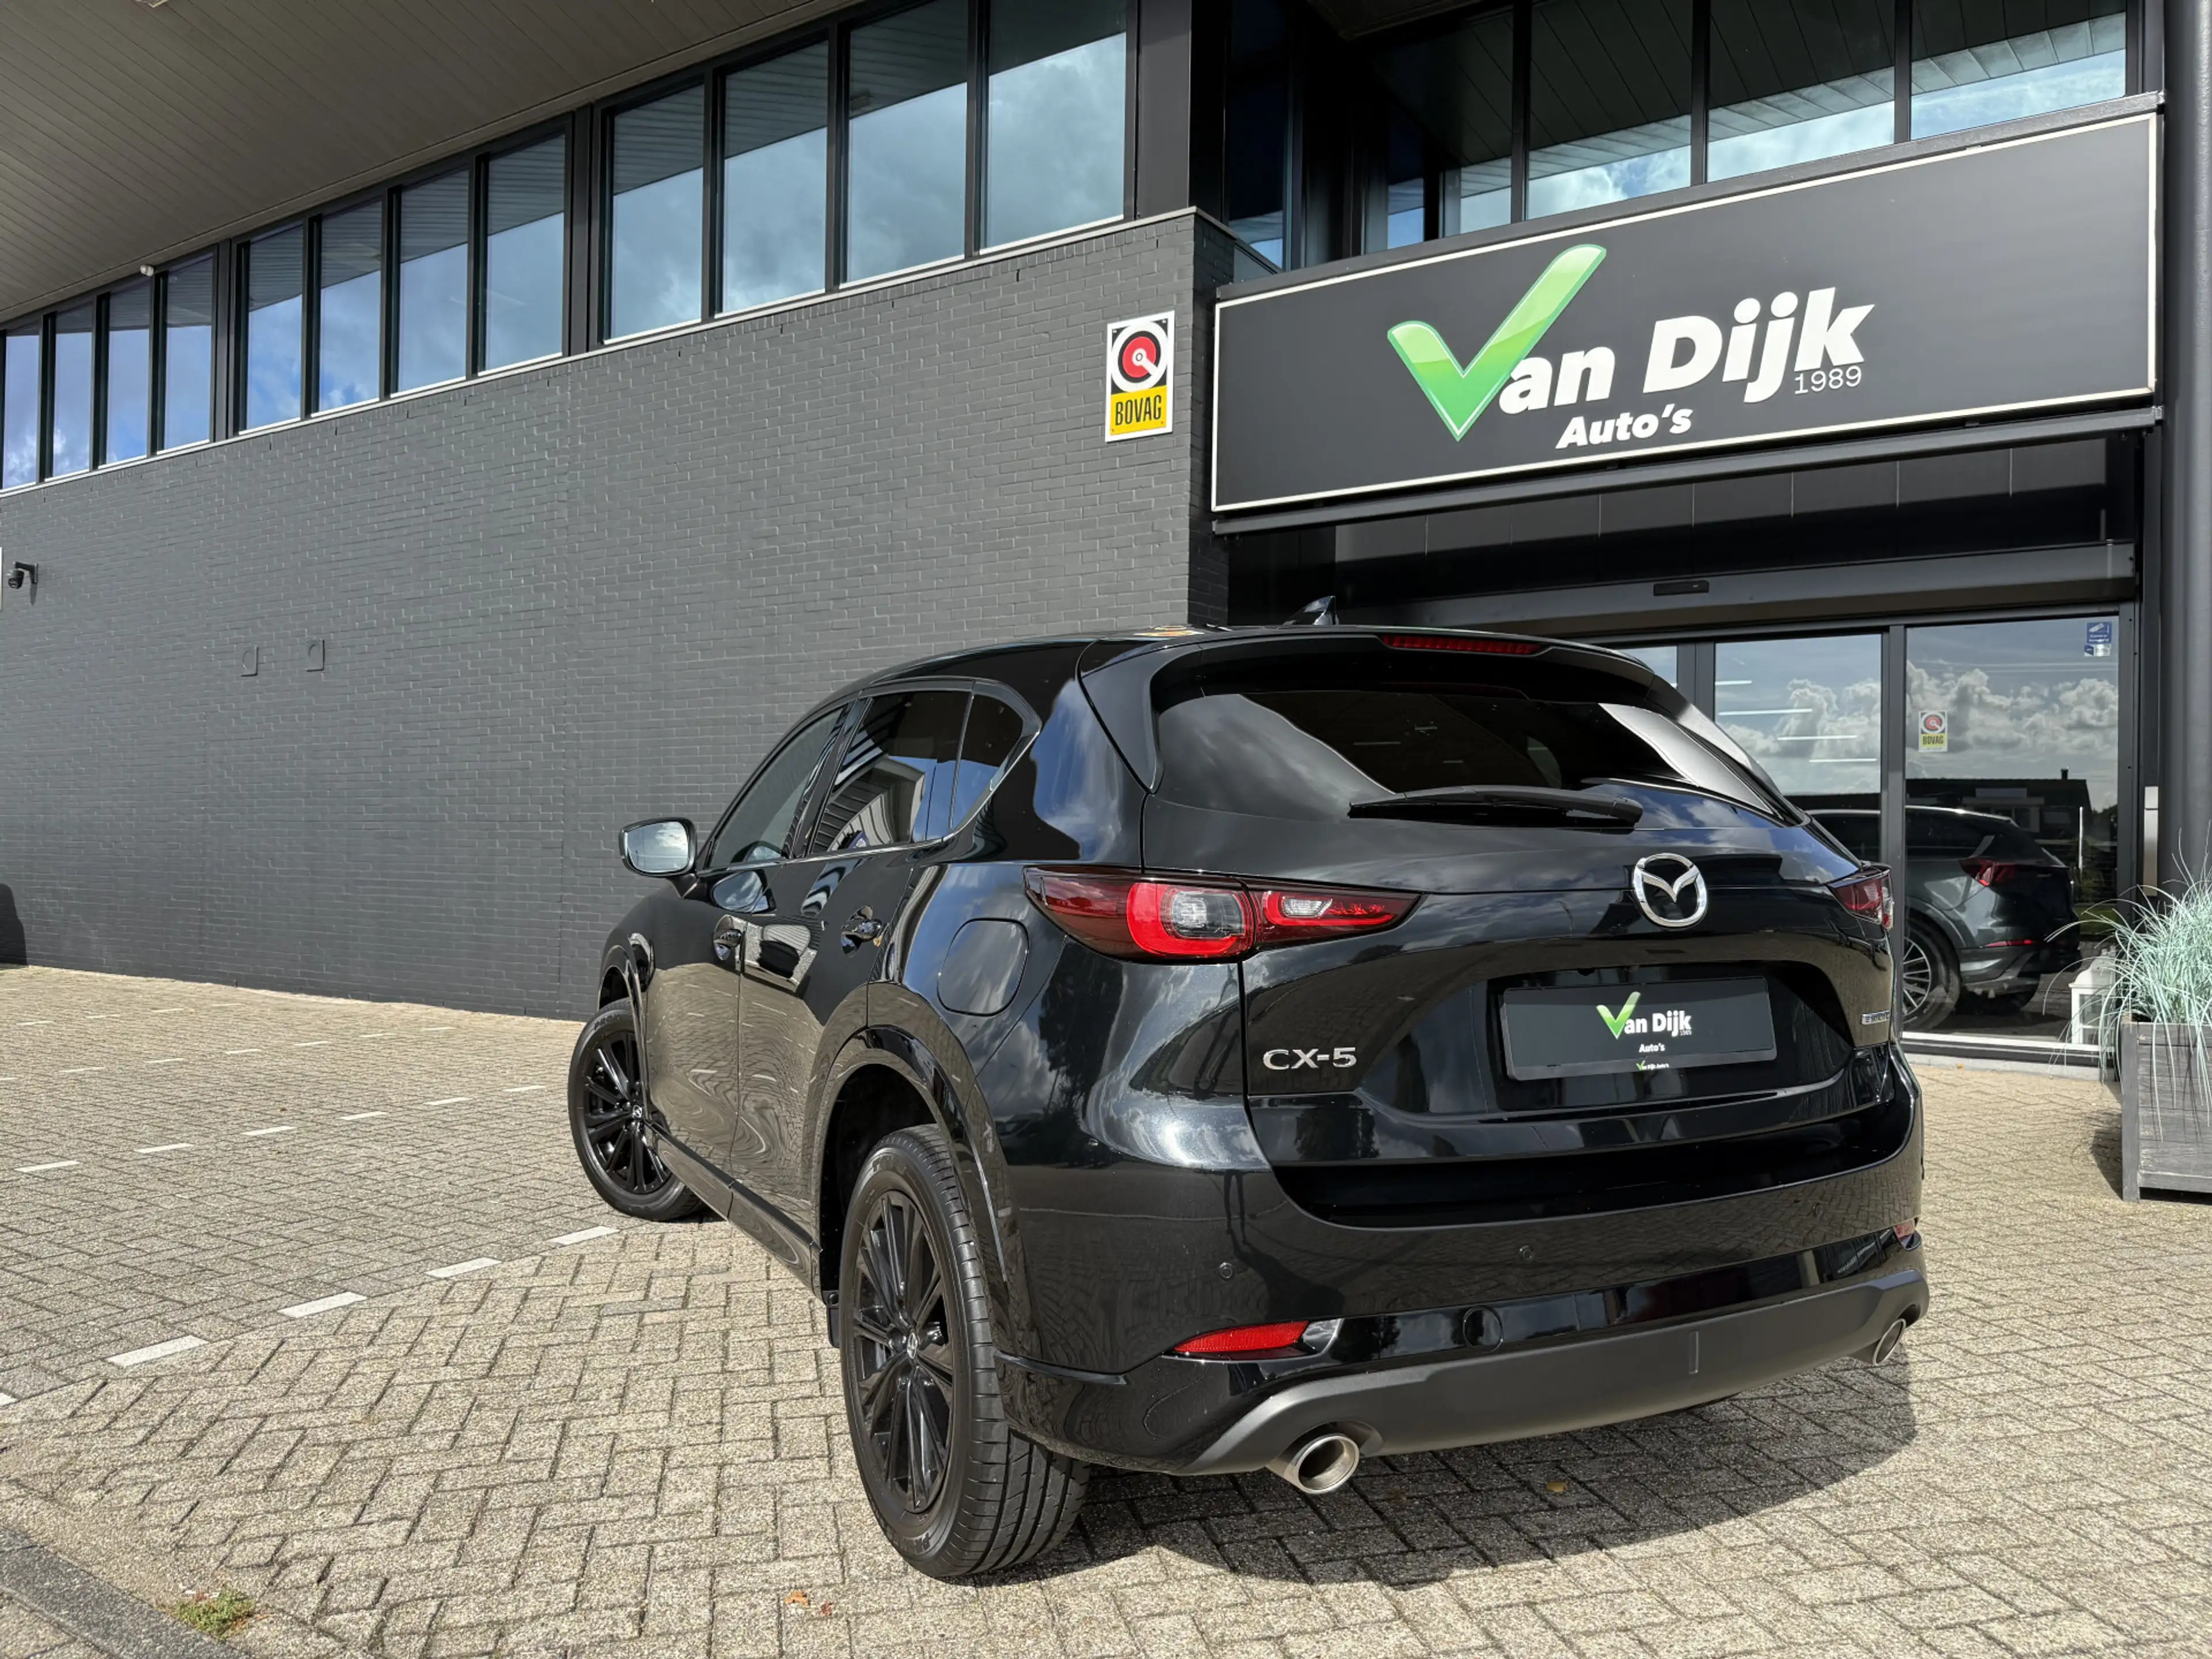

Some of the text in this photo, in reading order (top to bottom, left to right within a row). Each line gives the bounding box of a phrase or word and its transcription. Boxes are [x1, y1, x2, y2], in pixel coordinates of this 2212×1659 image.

[1387, 244, 1876, 442] Van Dijk
[1794, 365, 1862, 395] 1989
[1115, 395, 1162, 426] BOVAG
[1555, 404, 1693, 450] Auto's
[1652, 1010, 1692, 1037] Dijk
[1263, 1047, 1357, 1070] CX-5
[1639, 1043, 1665, 1053] Auto's
